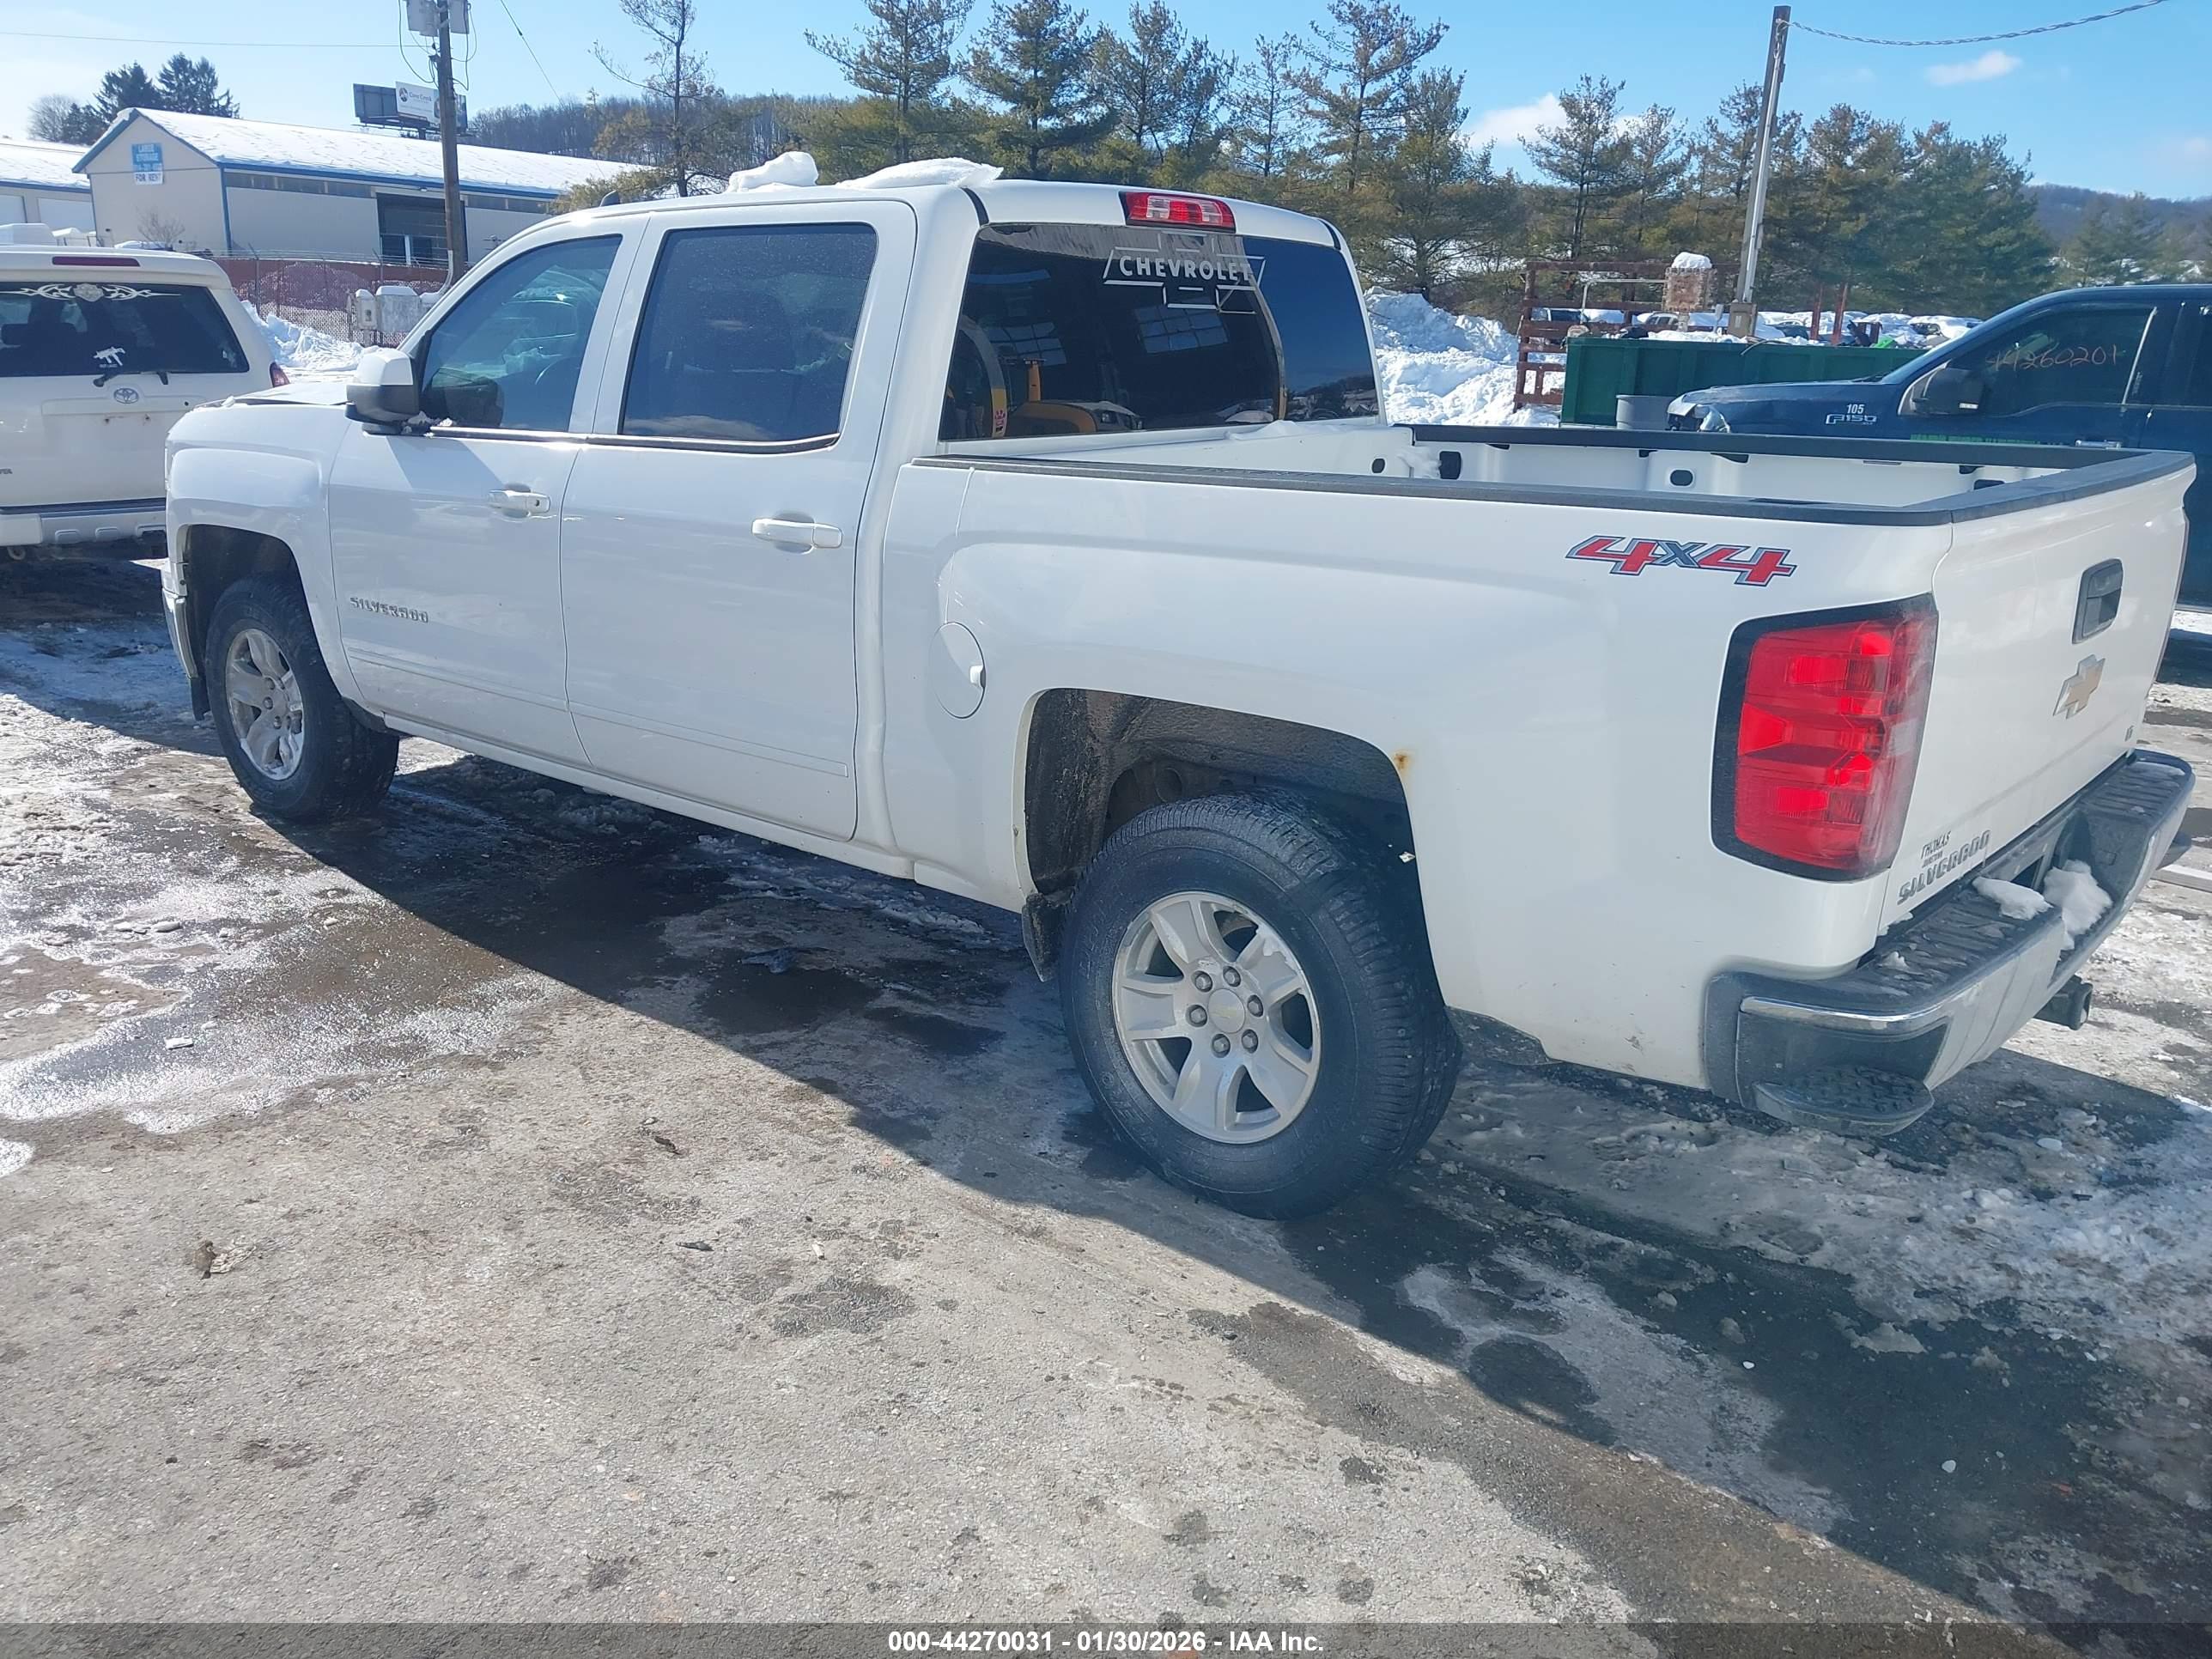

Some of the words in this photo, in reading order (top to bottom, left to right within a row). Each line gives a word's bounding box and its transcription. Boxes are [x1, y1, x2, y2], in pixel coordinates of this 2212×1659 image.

[1119, 255, 1252, 282] CHEVROLET
[1846, 403, 1865, 414] 105
[349, 597, 429, 623] SILVERADO
[1896, 830, 1991, 906] SILVERADO
